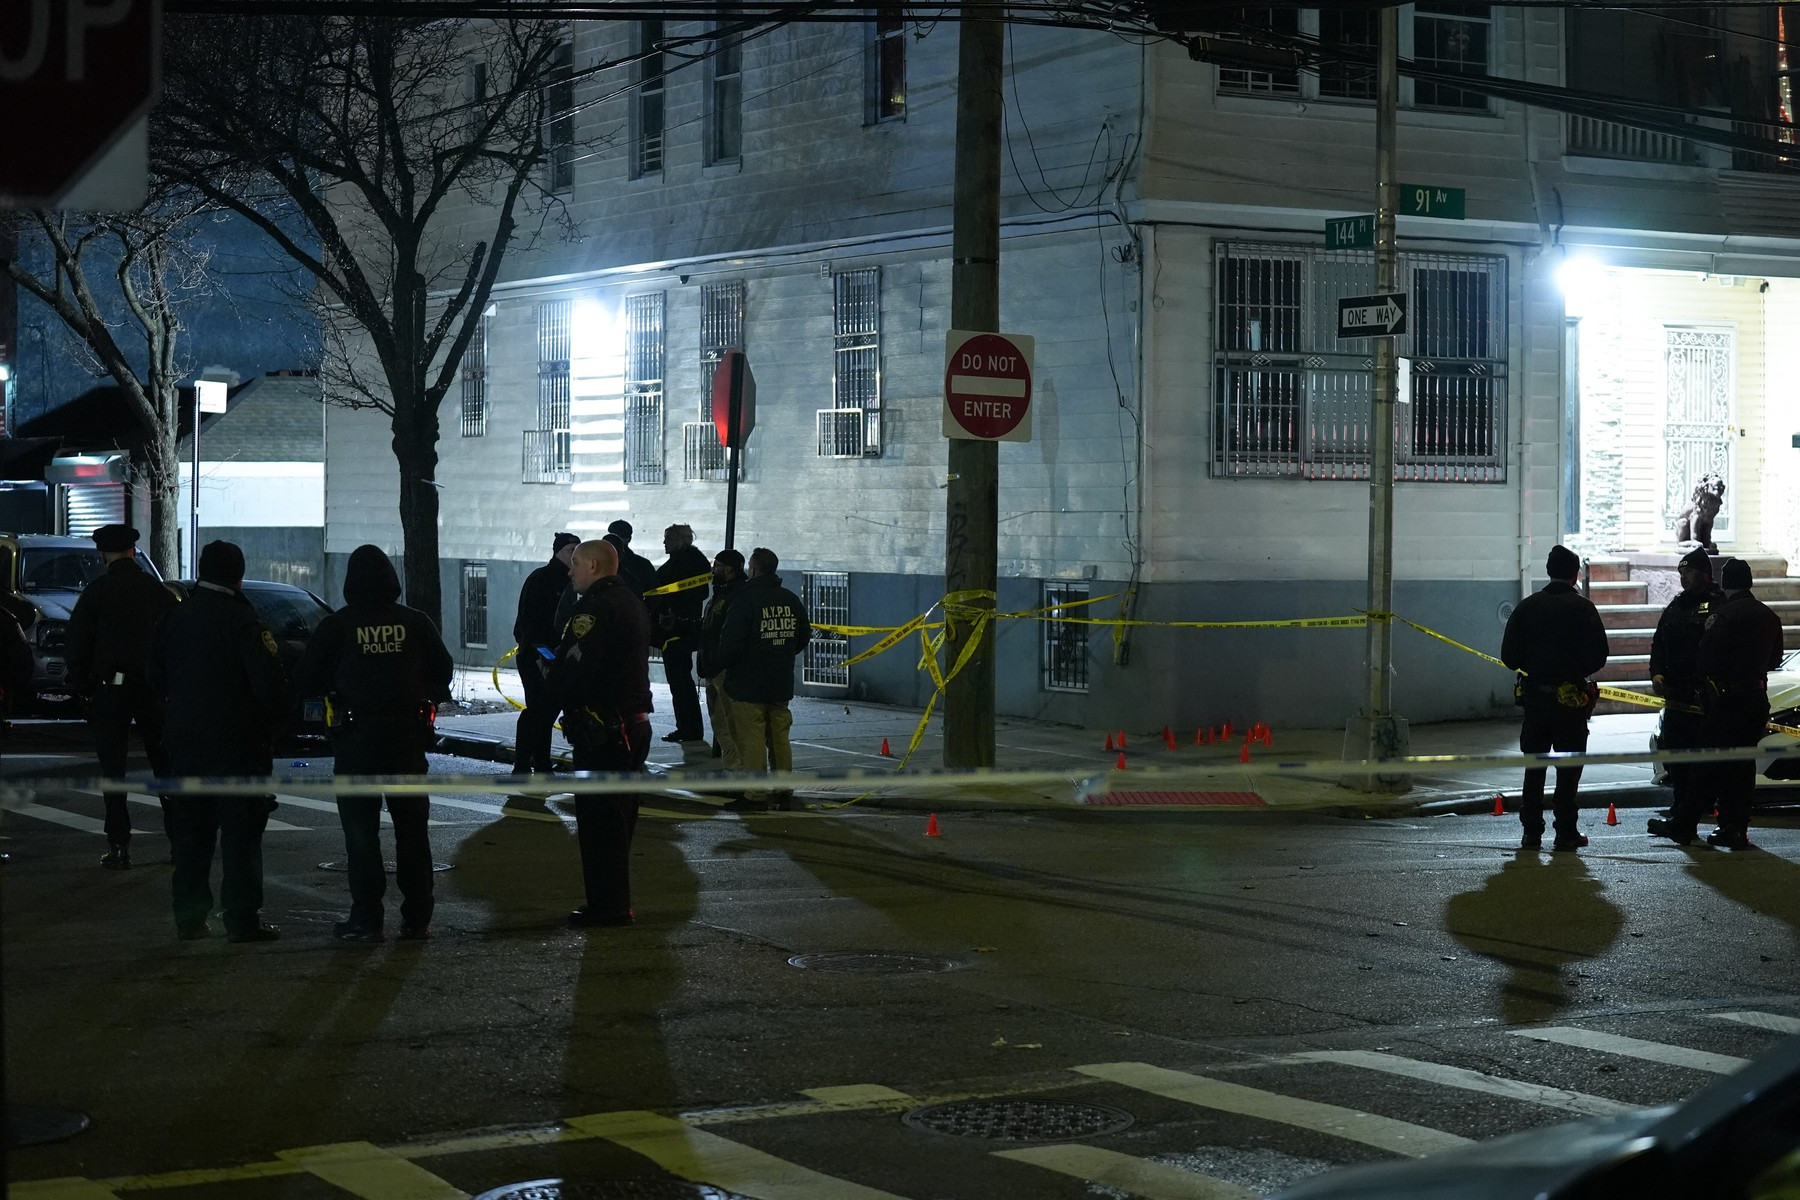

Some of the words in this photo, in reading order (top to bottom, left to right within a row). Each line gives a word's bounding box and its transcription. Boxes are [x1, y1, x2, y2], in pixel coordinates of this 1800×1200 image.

[0, 0, 134, 81] OP
[1415, 189, 1430, 213] 91
[1436, 189, 1448, 203] Av
[1335, 221, 1356, 246] 144
[1360, 218, 1367, 232] Pl
[1347, 309, 1368, 326] ONE
[1376, 306, 1397, 324] WAY
[961, 353, 982, 370] DO
[988, 355, 1017, 373] NOT
[963, 400, 1012, 419] ENTER
[762, 605, 795, 619] N.Y.P.D.
[356, 624, 406, 645] NYPD
[760, 618, 797, 632] POLICE
[760, 631, 779, 640] CRIME
[779, 630, 796, 638] SCENE
[772, 638, 786, 646] UNIT
[362, 641, 402, 655] POLICE
